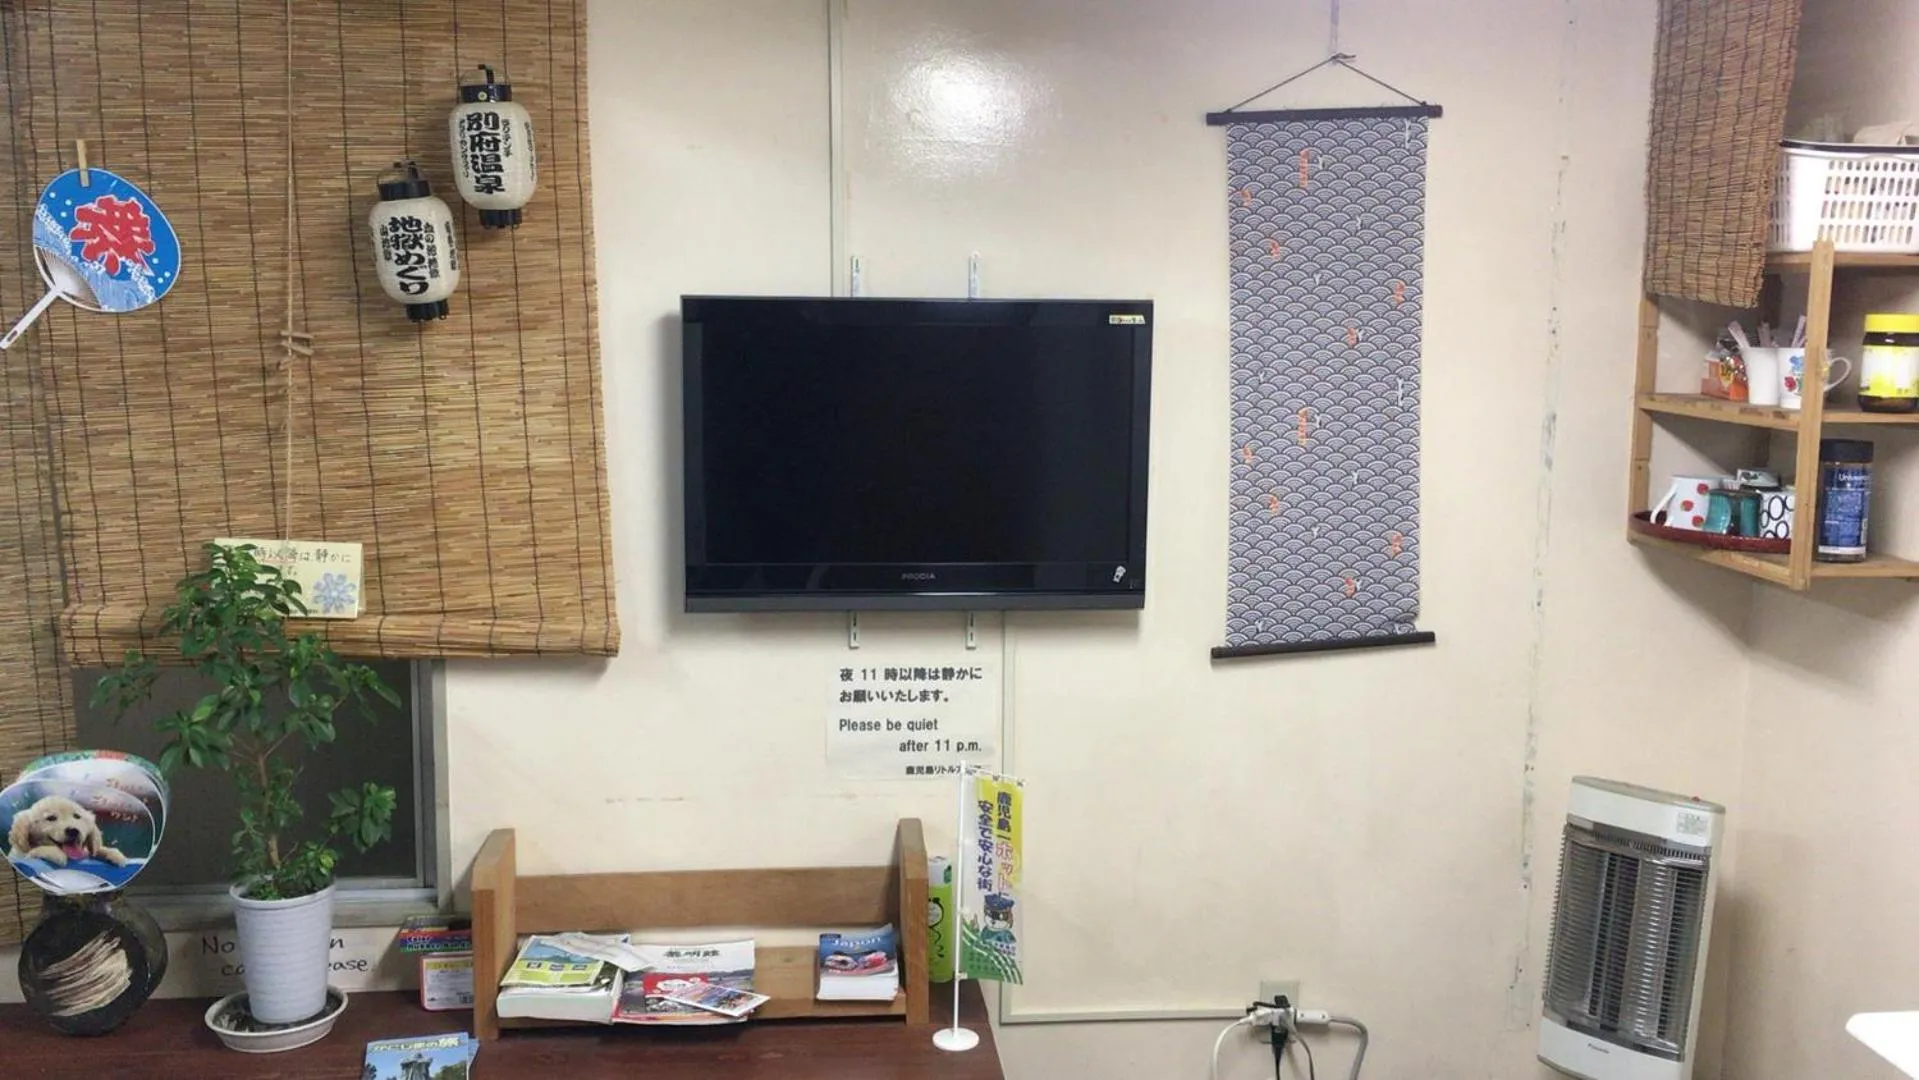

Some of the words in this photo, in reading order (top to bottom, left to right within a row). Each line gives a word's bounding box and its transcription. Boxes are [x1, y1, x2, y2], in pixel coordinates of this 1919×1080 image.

[466, 112, 505, 194] 別府温泉
[389, 216, 429, 295] 地獄めぐり
[840, 668, 853, 681] 夜
[861, 668, 876, 680] 11
[884, 667, 982, 681] 時以降は静かに
[840, 689, 949, 702] お願いいたします。
[839, 718, 881, 731] Please
[886, 718, 902, 731] be
[907, 718, 938, 731] quiet
[899, 740, 928, 752] after
[935, 740, 950, 751] 11
[956, 741, 982, 752] p.m.
[977, 799, 994, 892] 安全で安心な街
[201, 935, 236, 955] No
